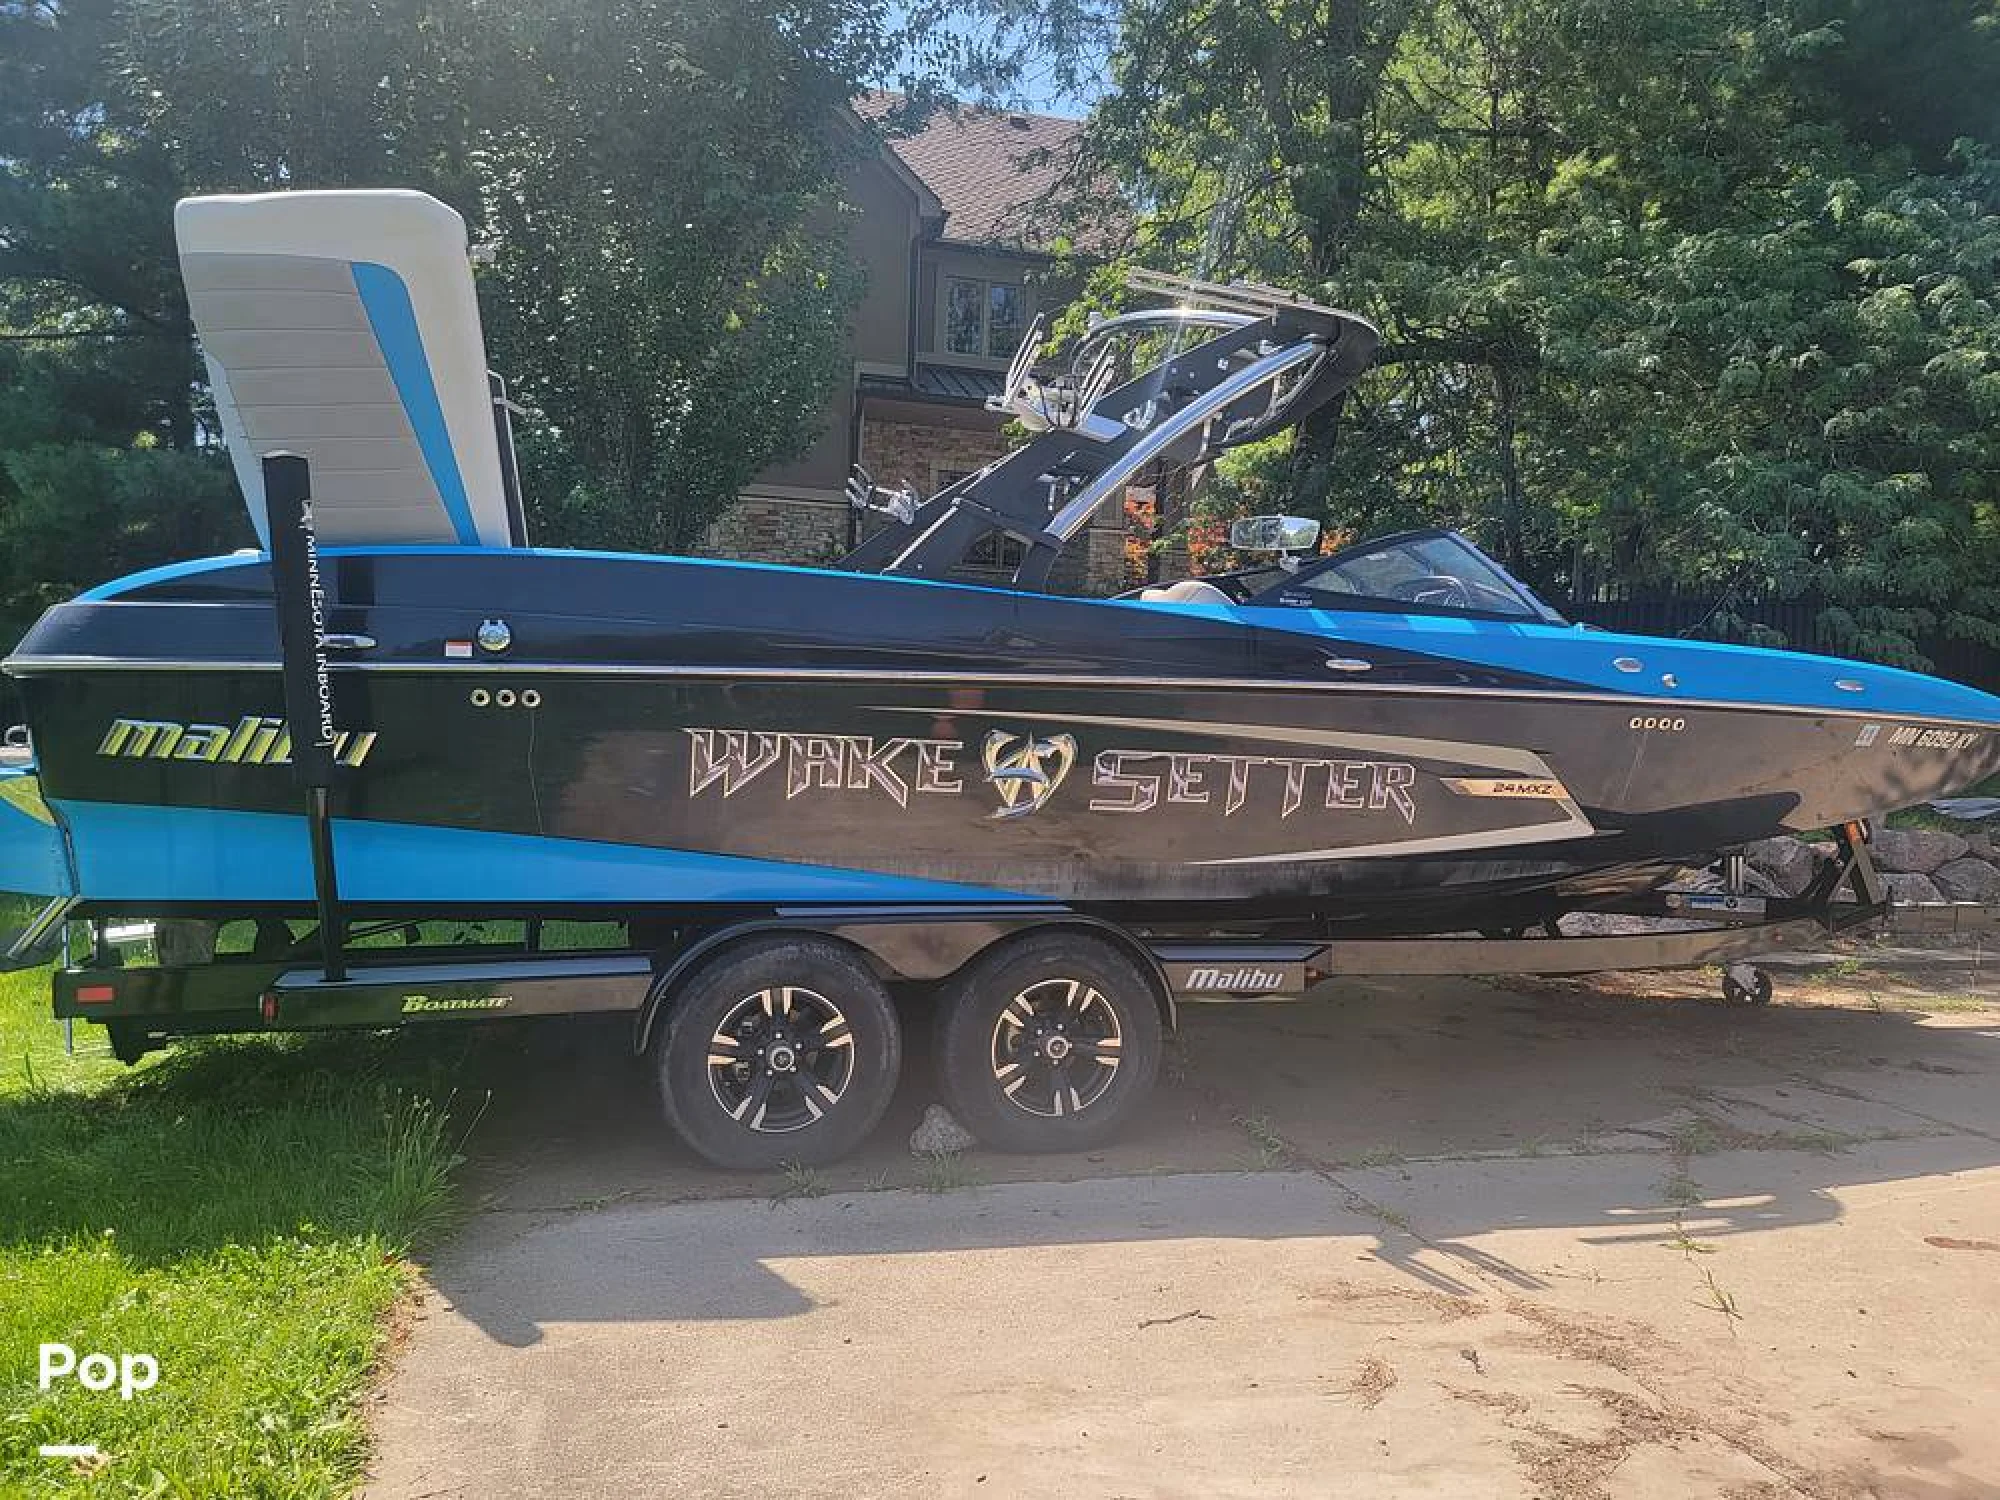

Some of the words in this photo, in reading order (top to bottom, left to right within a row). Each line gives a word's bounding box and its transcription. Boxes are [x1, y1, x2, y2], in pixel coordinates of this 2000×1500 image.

[305, 535, 326, 648] MINNESOTA
[315, 653, 334, 740] INBOARD
[680, 727, 964, 810] WAKE
[1089, 749, 1416, 825] SETTER
[1185, 968, 1284, 989] Malibu
